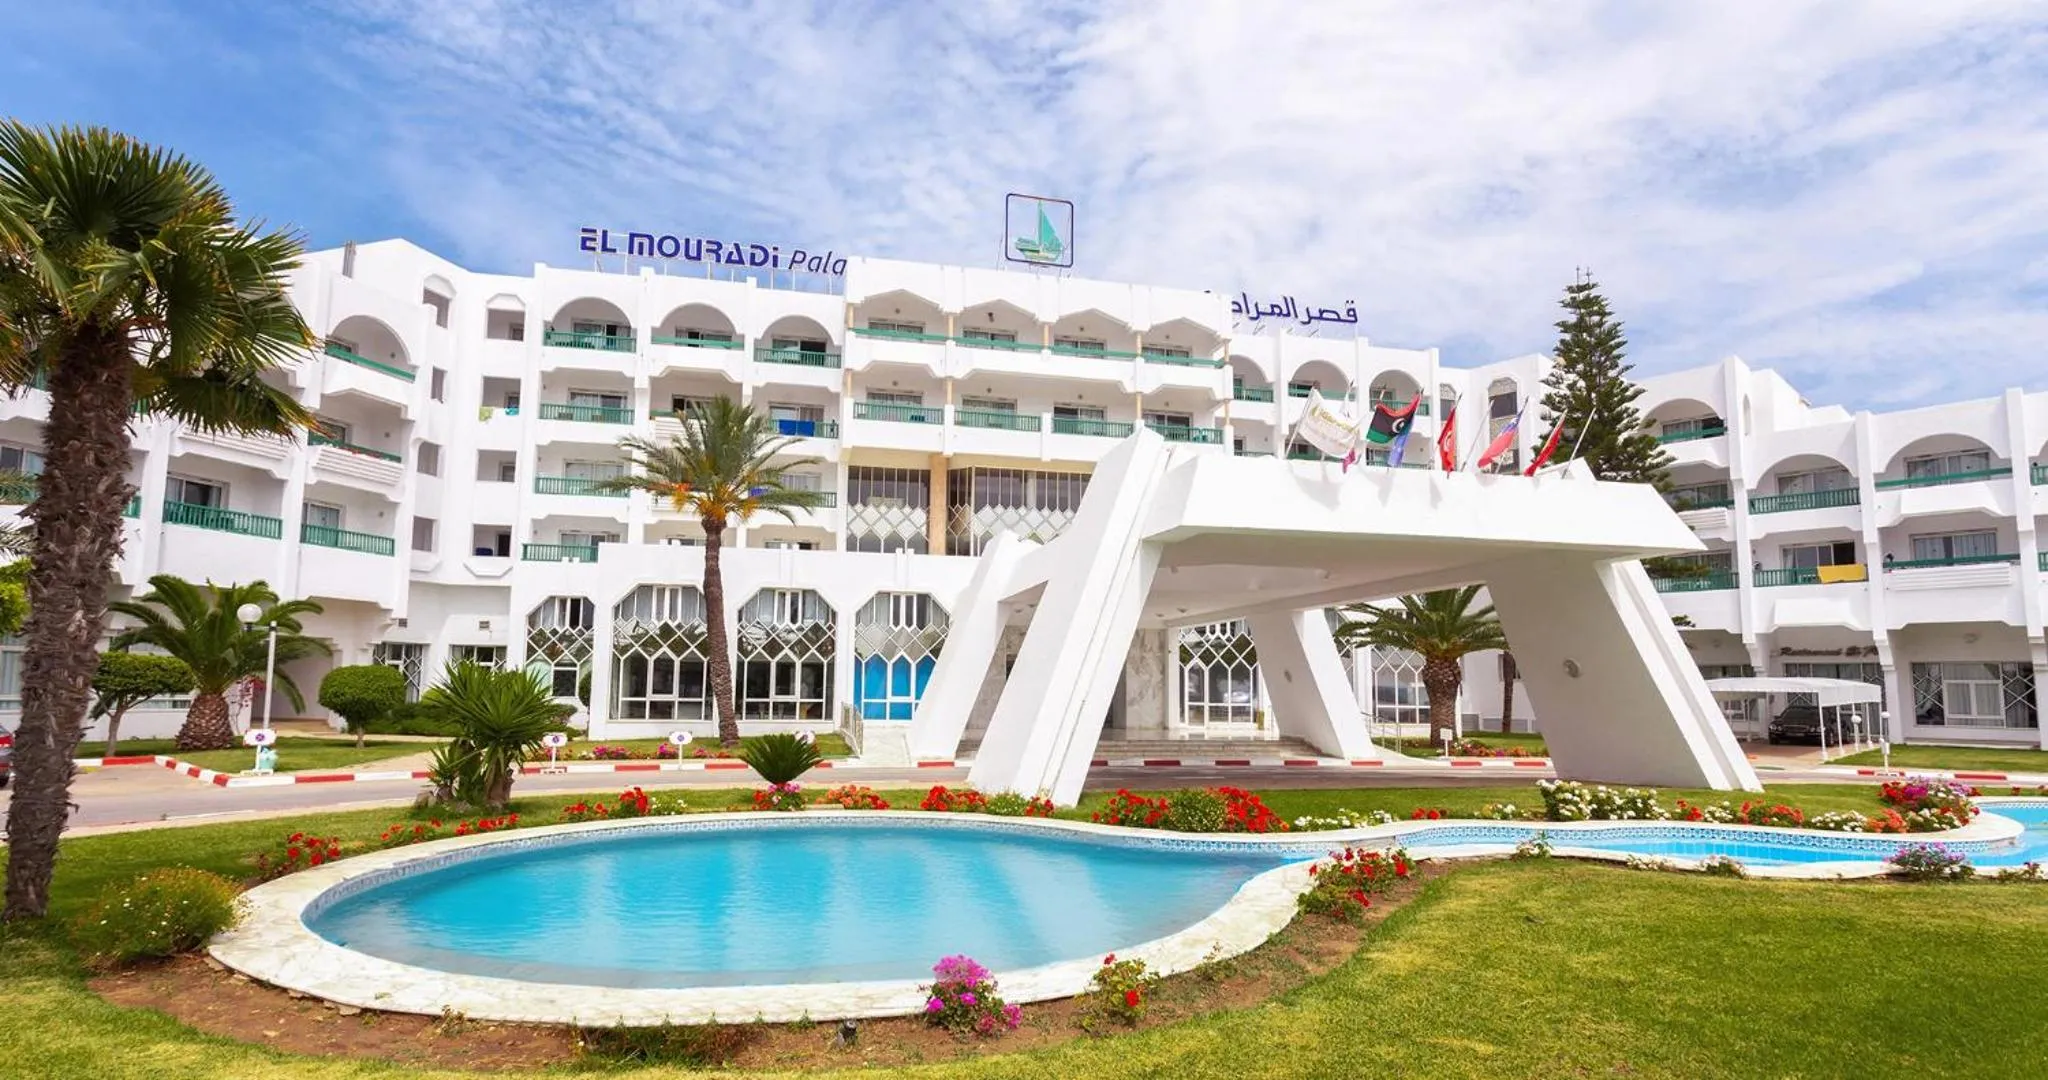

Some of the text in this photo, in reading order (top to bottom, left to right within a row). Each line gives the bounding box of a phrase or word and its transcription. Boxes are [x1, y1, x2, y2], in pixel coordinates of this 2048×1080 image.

[580, 227, 617, 254] EL
[788, 249, 848, 276] Pala
[1230, 291, 1358, 325] قصر المراد
